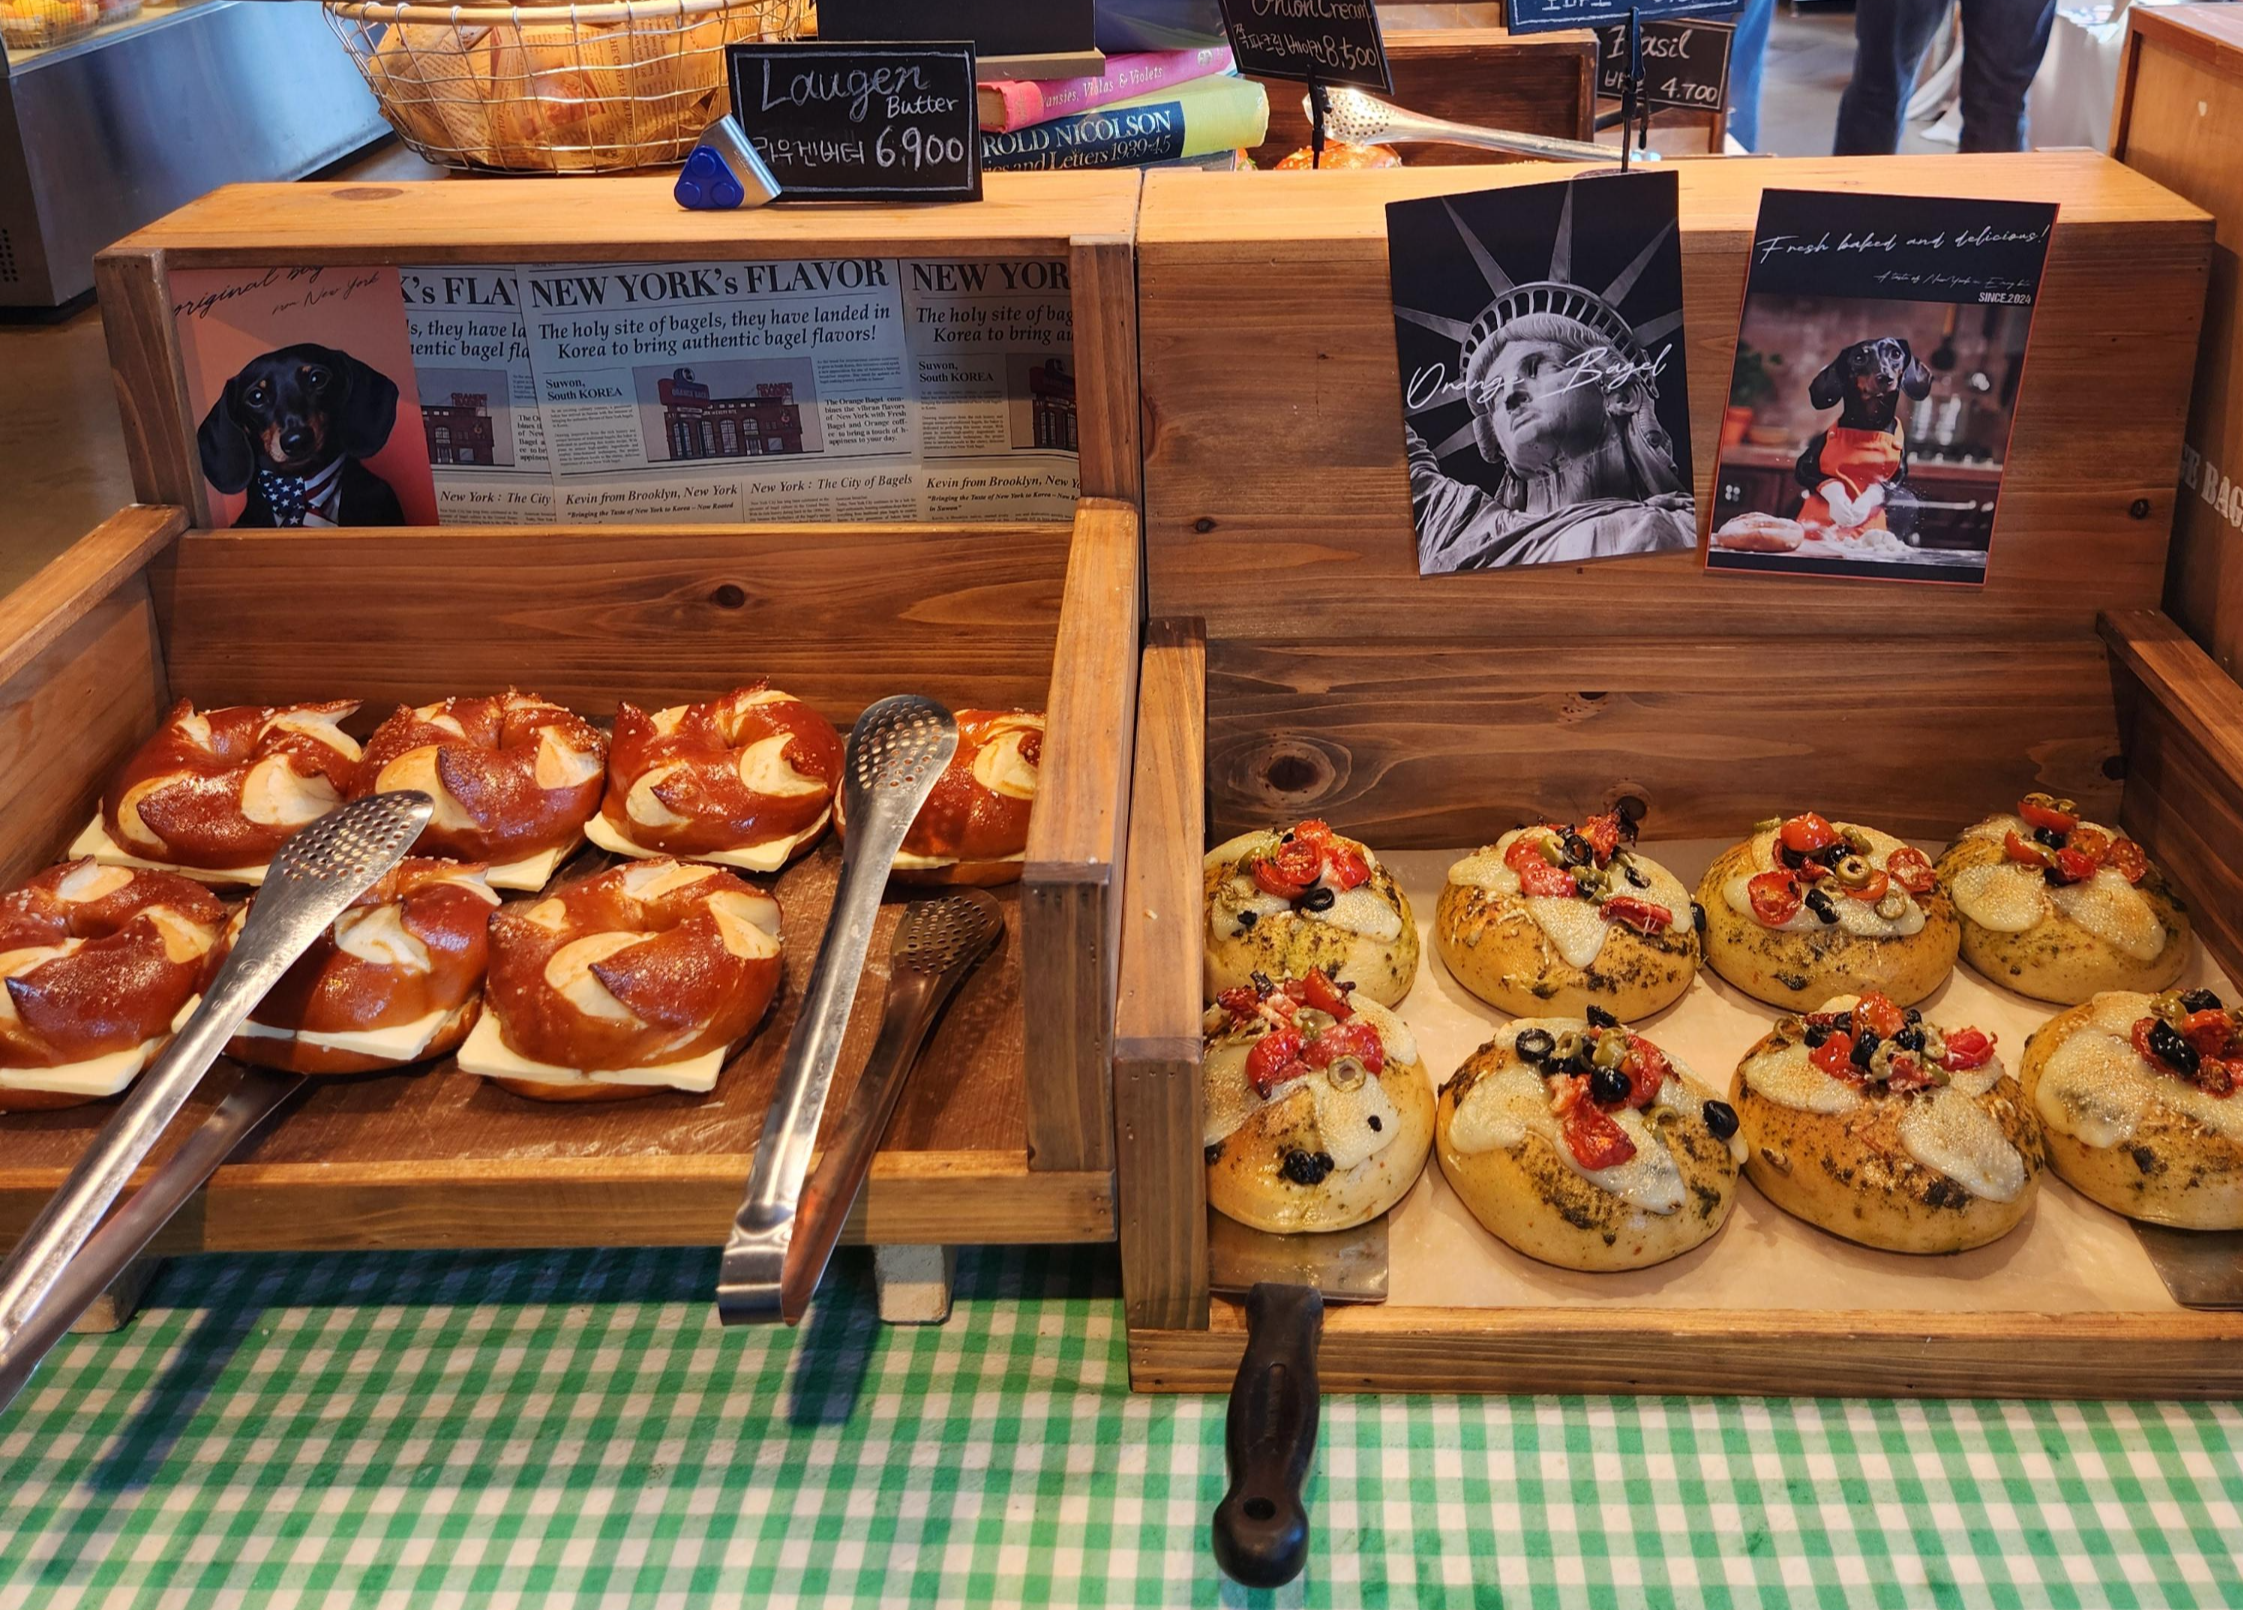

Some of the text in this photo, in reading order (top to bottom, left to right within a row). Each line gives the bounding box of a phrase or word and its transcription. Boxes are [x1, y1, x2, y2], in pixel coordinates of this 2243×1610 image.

[762, 58, 930, 122] Laugen
[1043, 89, 1080, 108] ansies,
[1129, 67, 1163, 84] Violets
[886, 95, 959, 119] Butter
[1056, 110, 1171, 147] NICOLSON
[1050, 149, 1109, 169] Letters
[1756, 224, 2050, 264] Fresh baked and delicious!
[528, 259, 889, 308] NEW YORK's FLAVOR
[910, 261, 1071, 292] NEW YOR
[1978, 291, 2032, 305] SINCE 2024
[538, 303, 890, 341] The holy site of bagels, they have landed in
[916, 307, 945, 323] The
[950, 306, 986, 327] holy
[992, 305, 1021, 321] site
[1026, 305, 1044, 325] of
[428, 320, 463, 341] they
[469, 320, 507, 337] have
[933, 327, 981, 343] Korea
[988, 328, 1003, 341] to
[1010, 326, 1052, 346] bring
[461, 341, 504, 362] bagel
[558, 325, 877, 359] Korea to bring authentic bagel flavors!
[919, 361, 958, 371] Suwon,
[1407, 343, 1672, 409] Orange Bagel
[545, 379, 585, 389] Suwon,
[920, 373, 994, 383] South KOREA
[547, 387, 623, 401] South KOREA
[846, 430, 865, 438] bring
[750, 483, 776, 494] New
[780, 481, 805, 492] York
[818, 478, 838, 490] The
[841, 476, 861, 489] City
[864, 476, 876, 489] of
[878, 474, 913, 487] Bagels
[926, 477, 959, 489] Kevin
[960, 476, 987, 490] from
[989, 475, 1042, 489] Brooklyn,
[1045, 475, 1068, 487] New
[440, 490, 466, 502] New
[469, 491, 495, 503] York
[508, 492, 527, 504] The
[530, 493, 551, 506] City
[566, 484, 738, 506] Kevin from Brooklyn, New York
[2201, 461, 2243, 533] BAG
[599, 507, 609, 516] the
